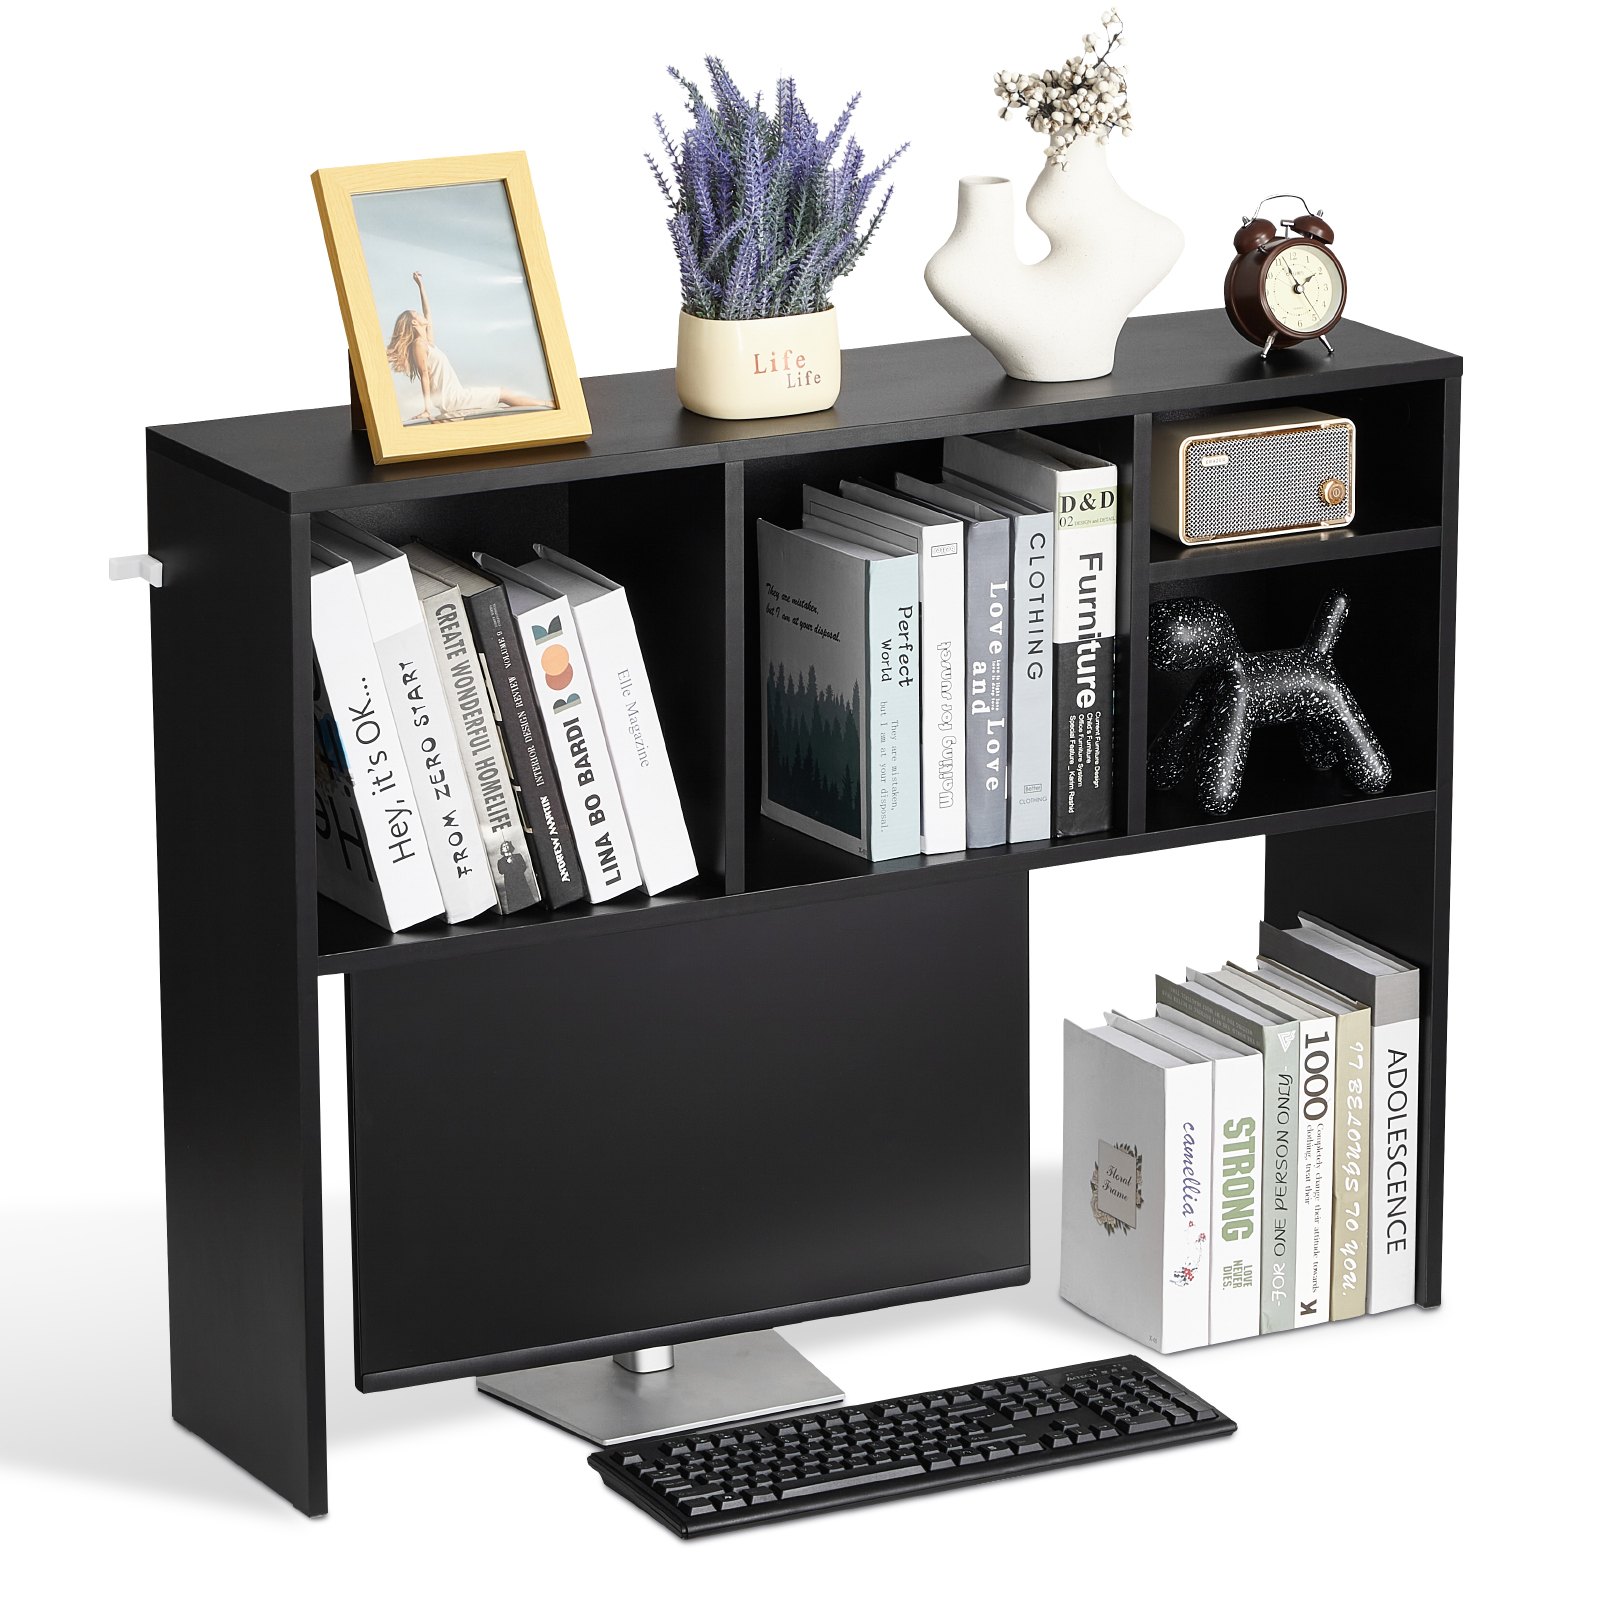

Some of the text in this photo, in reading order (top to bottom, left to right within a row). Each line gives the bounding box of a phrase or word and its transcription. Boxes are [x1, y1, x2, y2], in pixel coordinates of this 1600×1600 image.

[753, 349, 806, 375] Life
[786, 370, 821, 389] Life
[1059, 515, 1074, 527] 02
[766, 582, 780, 601] They
[1027, 531, 1046, 680] CLOTHING
[766, 603, 775, 616] but
[792, 616, 799, 626] at
[799, 619, 813, 631] your
[813, 623, 841, 643] disposal.
[988, 580, 1009, 656] Love
[1075, 551, 1103, 709] Furniture
[499, 637, 513, 669] VOLUME
[879, 638, 893, 683] World
[897, 605, 914, 689] Perfect
[508, 675, 524, 709] REVIEW
[879, 700, 889, 718] but
[970, 660, 989, 716] and
[435, 602, 513, 833] CREATE WONDERFUL HOMELIFE
[517, 709, 536, 745] DESIGN
[617, 668, 650, 769] Elle Magazine
[879, 731, 888, 744] am
[936, 640, 957, 809] Waiting for sunset
[348, 677, 416, 864] Hey, it's OK...
[400, 661, 473, 879] FROM ZERO START
[524, 744, 545, 788] INTERIOR
[562, 717, 595, 788] BARDI
[879, 747, 888, 758] at
[890, 719, 899, 812] They are mistaken,
[985, 717, 1007, 792] Love
[1085, 735, 1093, 764] Furniture
[1092, 711, 1102, 789] Current Furniture Design
[878, 762, 888, 784] your
[1076, 763, 1084, 788] System
[540, 796, 561, 834] MARTIN
[584, 793, 606, 826] BO
[879, 788, 888, 834] disposal.
[546, 832, 571, 883] ANDREW
[595, 831, 622, 887] LINA
[1303, 1030, 1330, 1121] 1000
[1181, 1121, 1201, 1217] camellia
[1274, 1130, 1289, 1211] PERSON
[1304, 1124, 1314, 1205] clothing, treat their
[1340, 1041, 1364, 1297] IT BELONGS TO YOU.
[1386, 1048, 1408, 1255] ADOLESCENCE
[1102, 1179, 1128, 1202] Frame
[1106, 1165, 1132, 1187] Floral
[1221, 1116, 1257, 1243] STRONG
[1311, 1123, 1325, 1294] Completely change their attitude towards
[1273, 1218, 1288, 1257] ONE
[1222, 1265, 1233, 1291] DIES.
[1232, 1259, 1243, 1289] NEVER
[1243, 1259, 1253, 1287] LOVE
[1299, 1298, 1317, 1316] K
